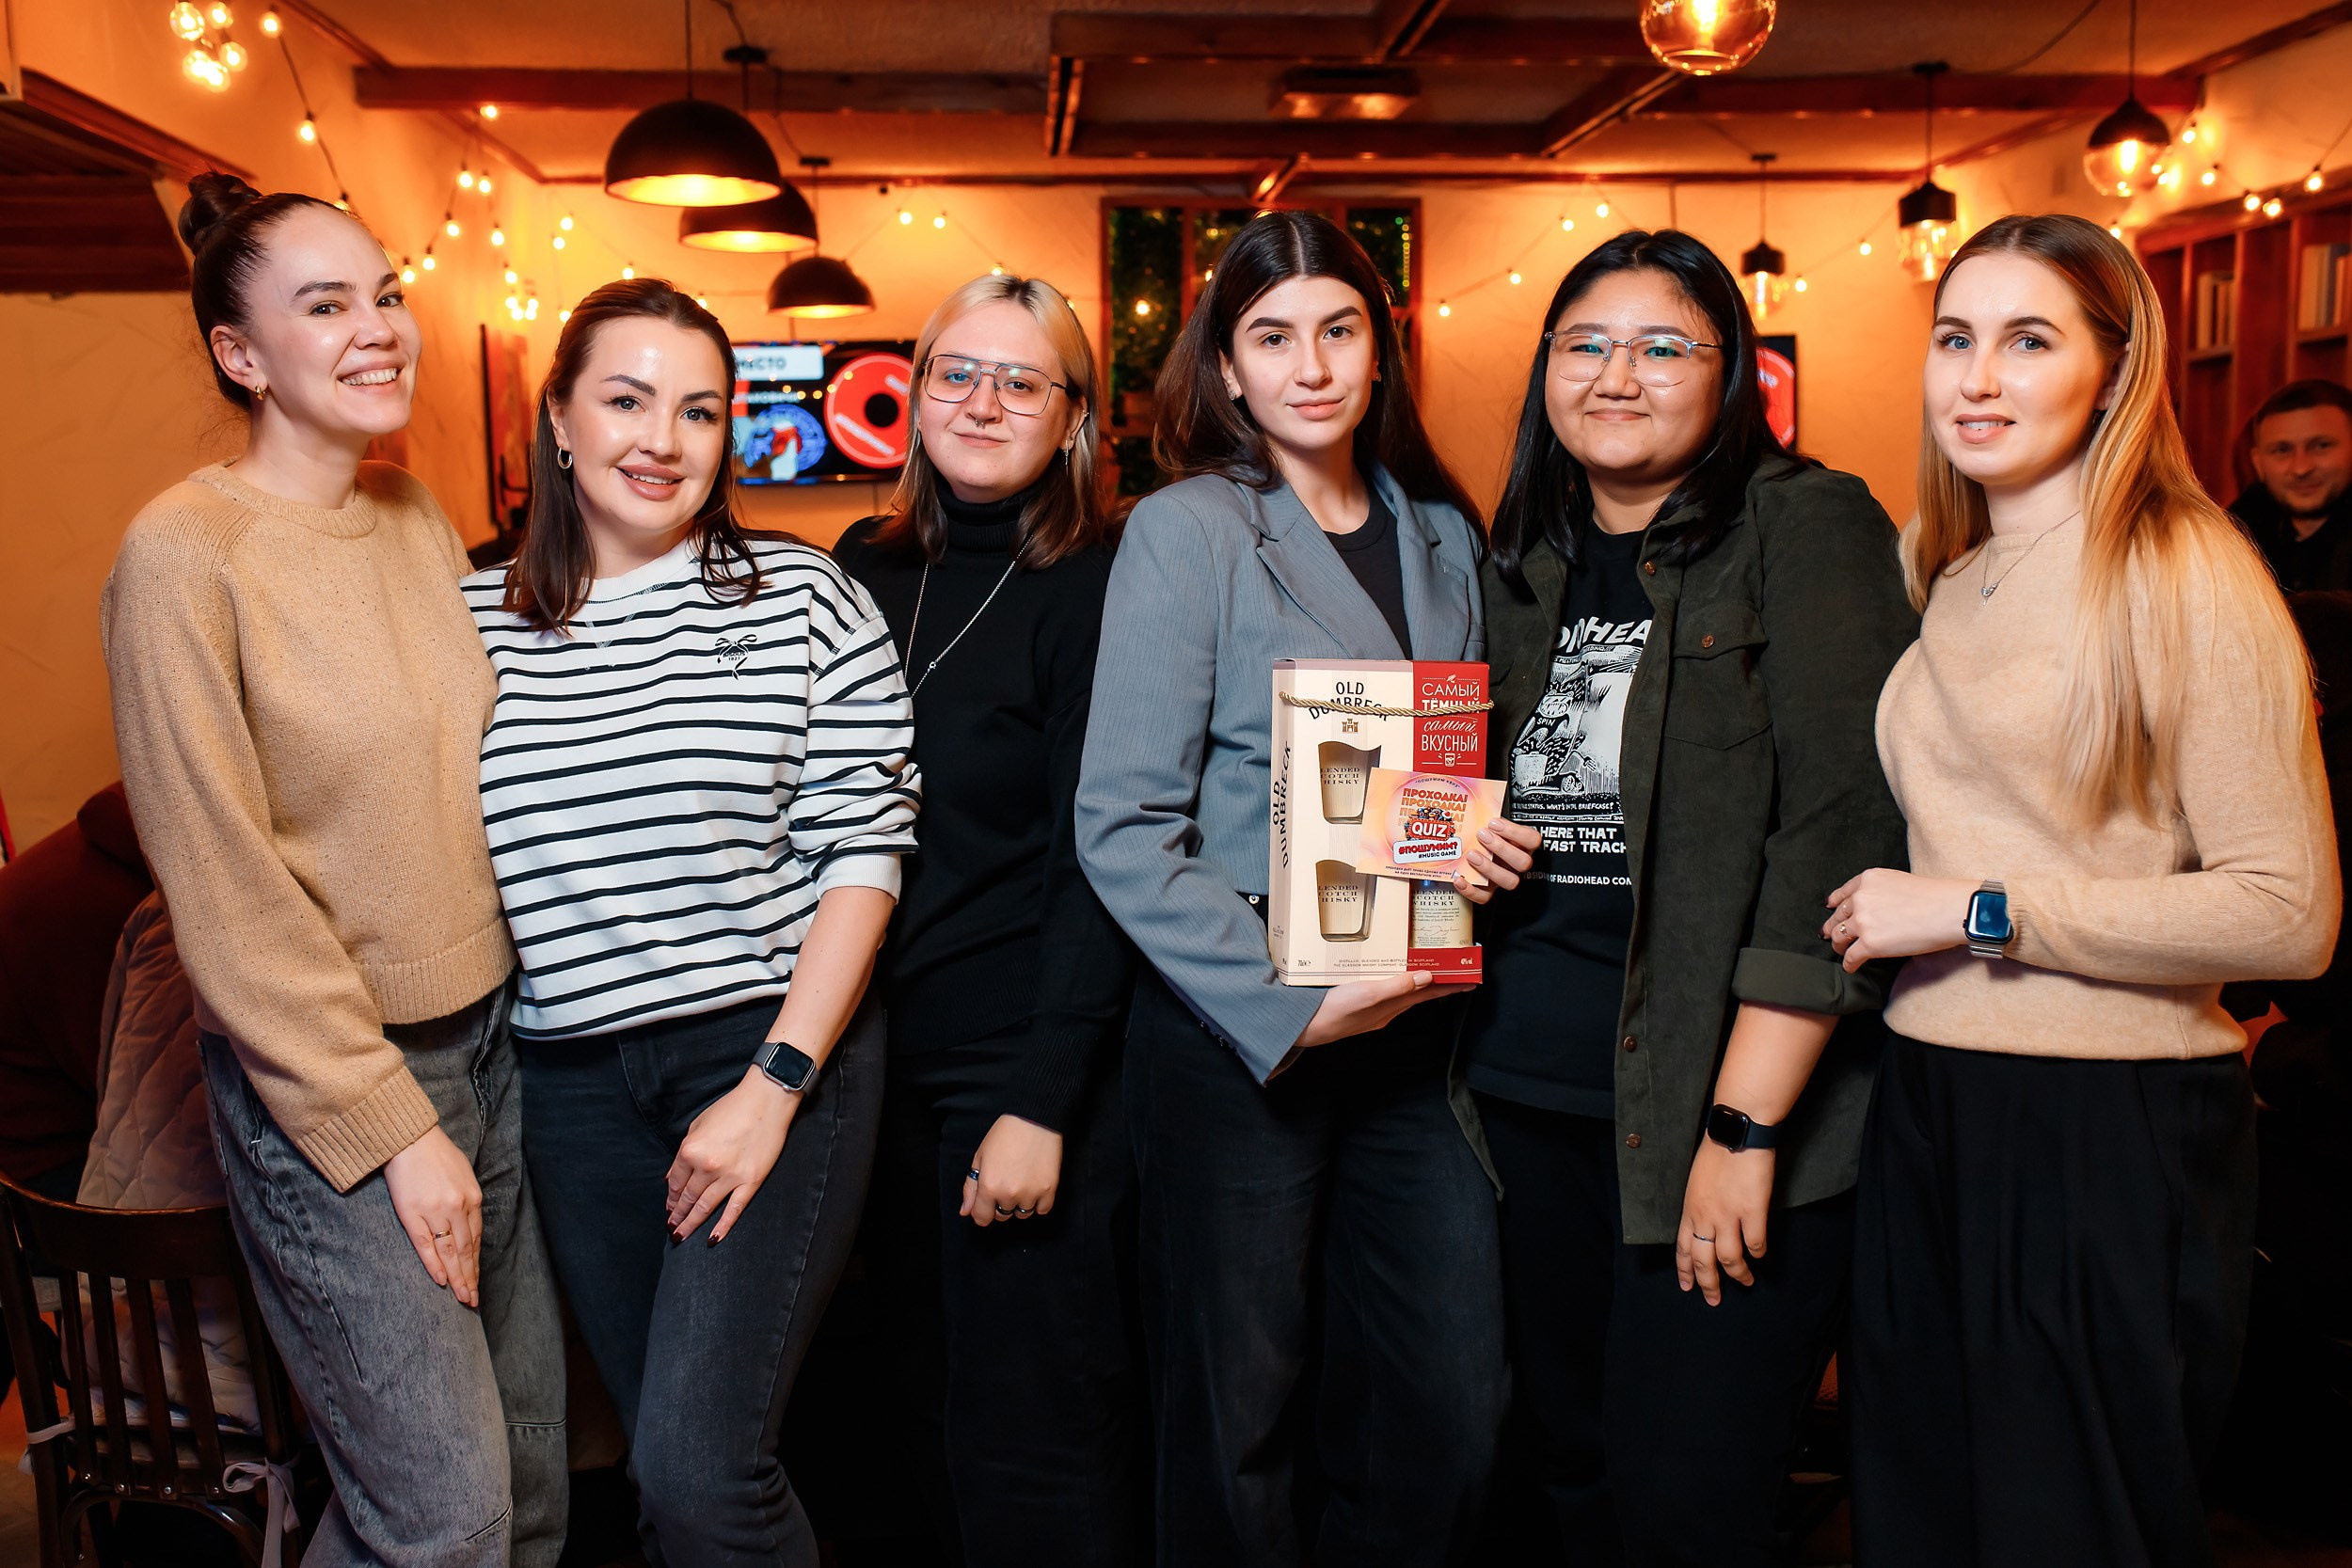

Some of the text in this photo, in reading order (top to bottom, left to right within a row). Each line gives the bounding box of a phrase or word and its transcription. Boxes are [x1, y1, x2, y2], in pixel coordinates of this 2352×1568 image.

[1335, 681, 1365, 695] OLD
[1422, 681, 1480, 697] САМЫЙ
[1423, 720, 1479, 733] самый
[1536, 717, 1556, 726] SPIN
[1422, 732, 1478, 752] ВКУСНЫЙ
[1402, 787, 1469, 803] ПРОХОДКА!
[1272, 780, 1280, 826] OLD
[1279, 739, 1292, 869] DUMBRECK
[1401, 797, 1467, 813] ПРОХОДКА!
[1578, 801, 1614, 810] BRIEFCASE?
[1411, 821, 1448, 838] QUIZ
[1577, 828, 1617, 839] THAT
[1543, 839, 1577, 852] FAST
[1557, 875, 1611, 885] RADIOHEAD
